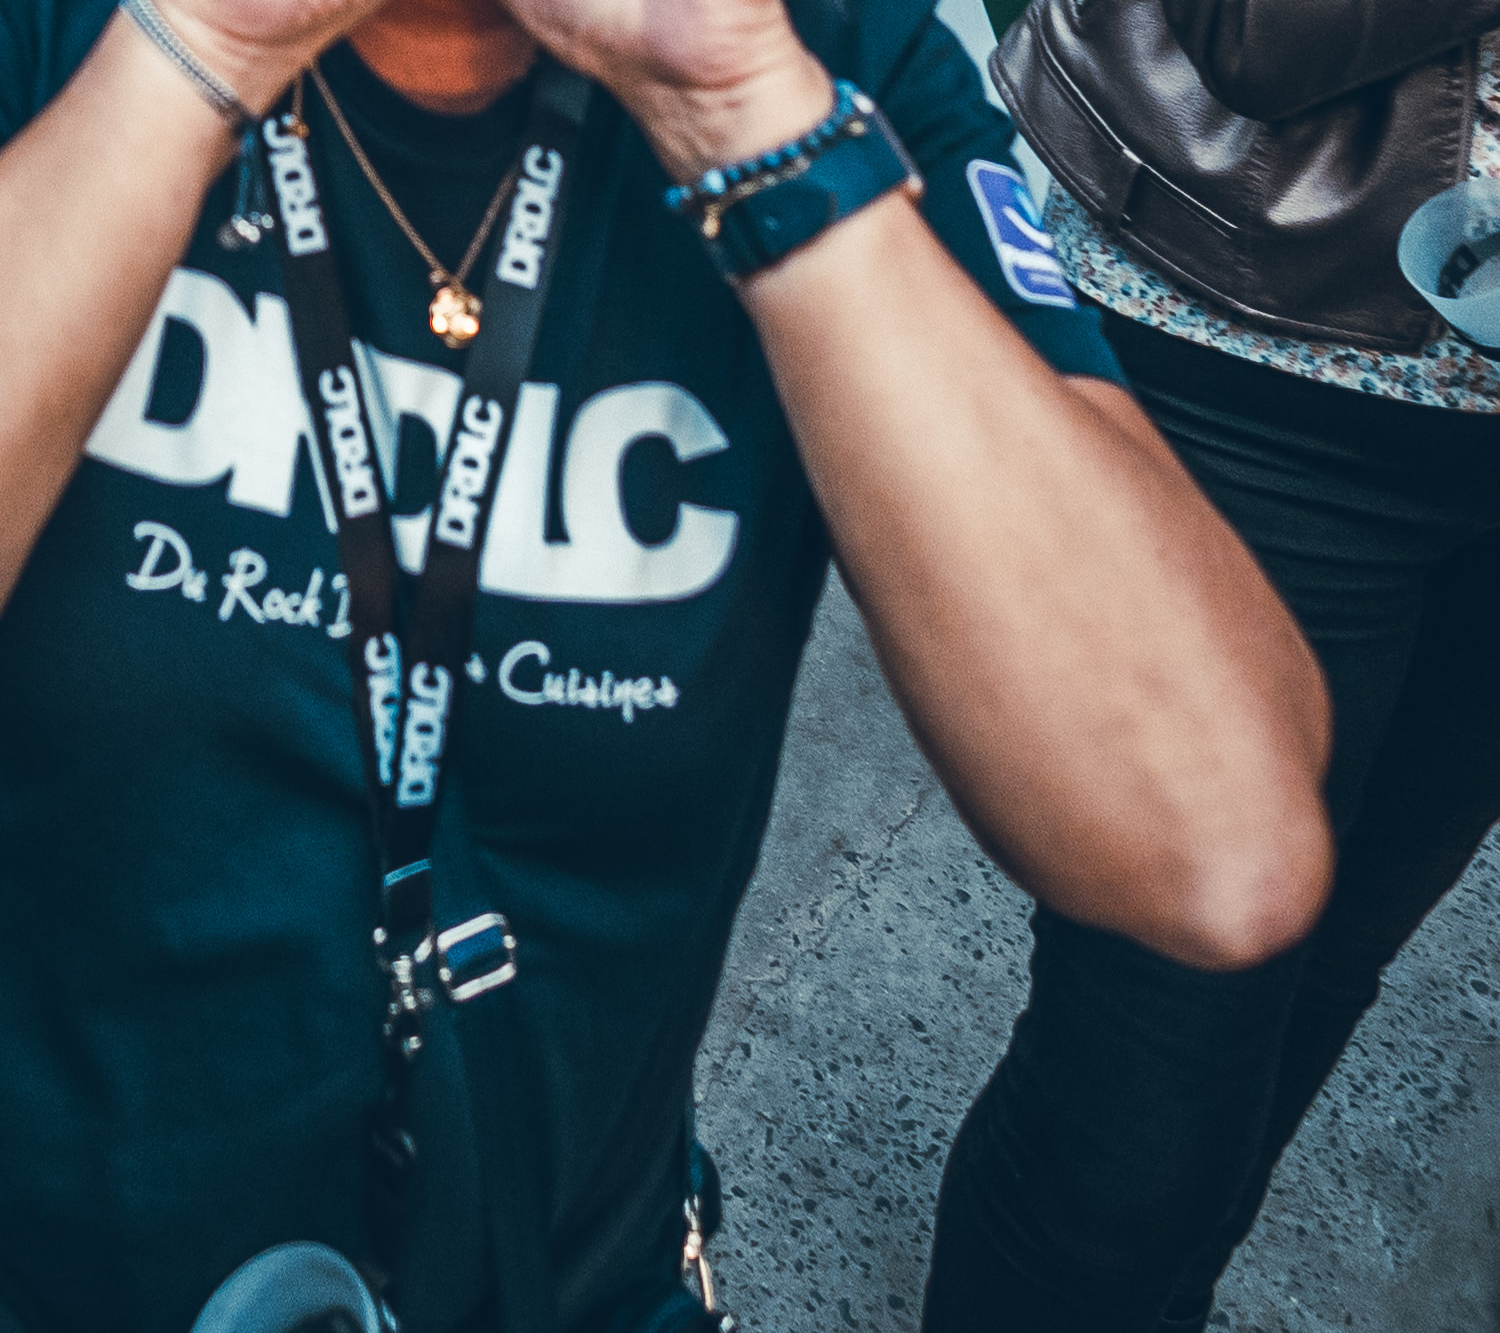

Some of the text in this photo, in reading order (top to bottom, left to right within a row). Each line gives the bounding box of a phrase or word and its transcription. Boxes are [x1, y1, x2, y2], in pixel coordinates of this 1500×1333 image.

[262, 113, 329, 256] DRDLC
[496, 143, 564, 290] DRDLC
[318, 364, 380, 520] DRDLC
[435, 394, 504, 550] DRDLC
[125, 520, 208, 603] Du
[217, 546, 324, 626] Rock
[499, 639, 680, 723] Cuisines
[397, 661, 453, 808] DRDLC
